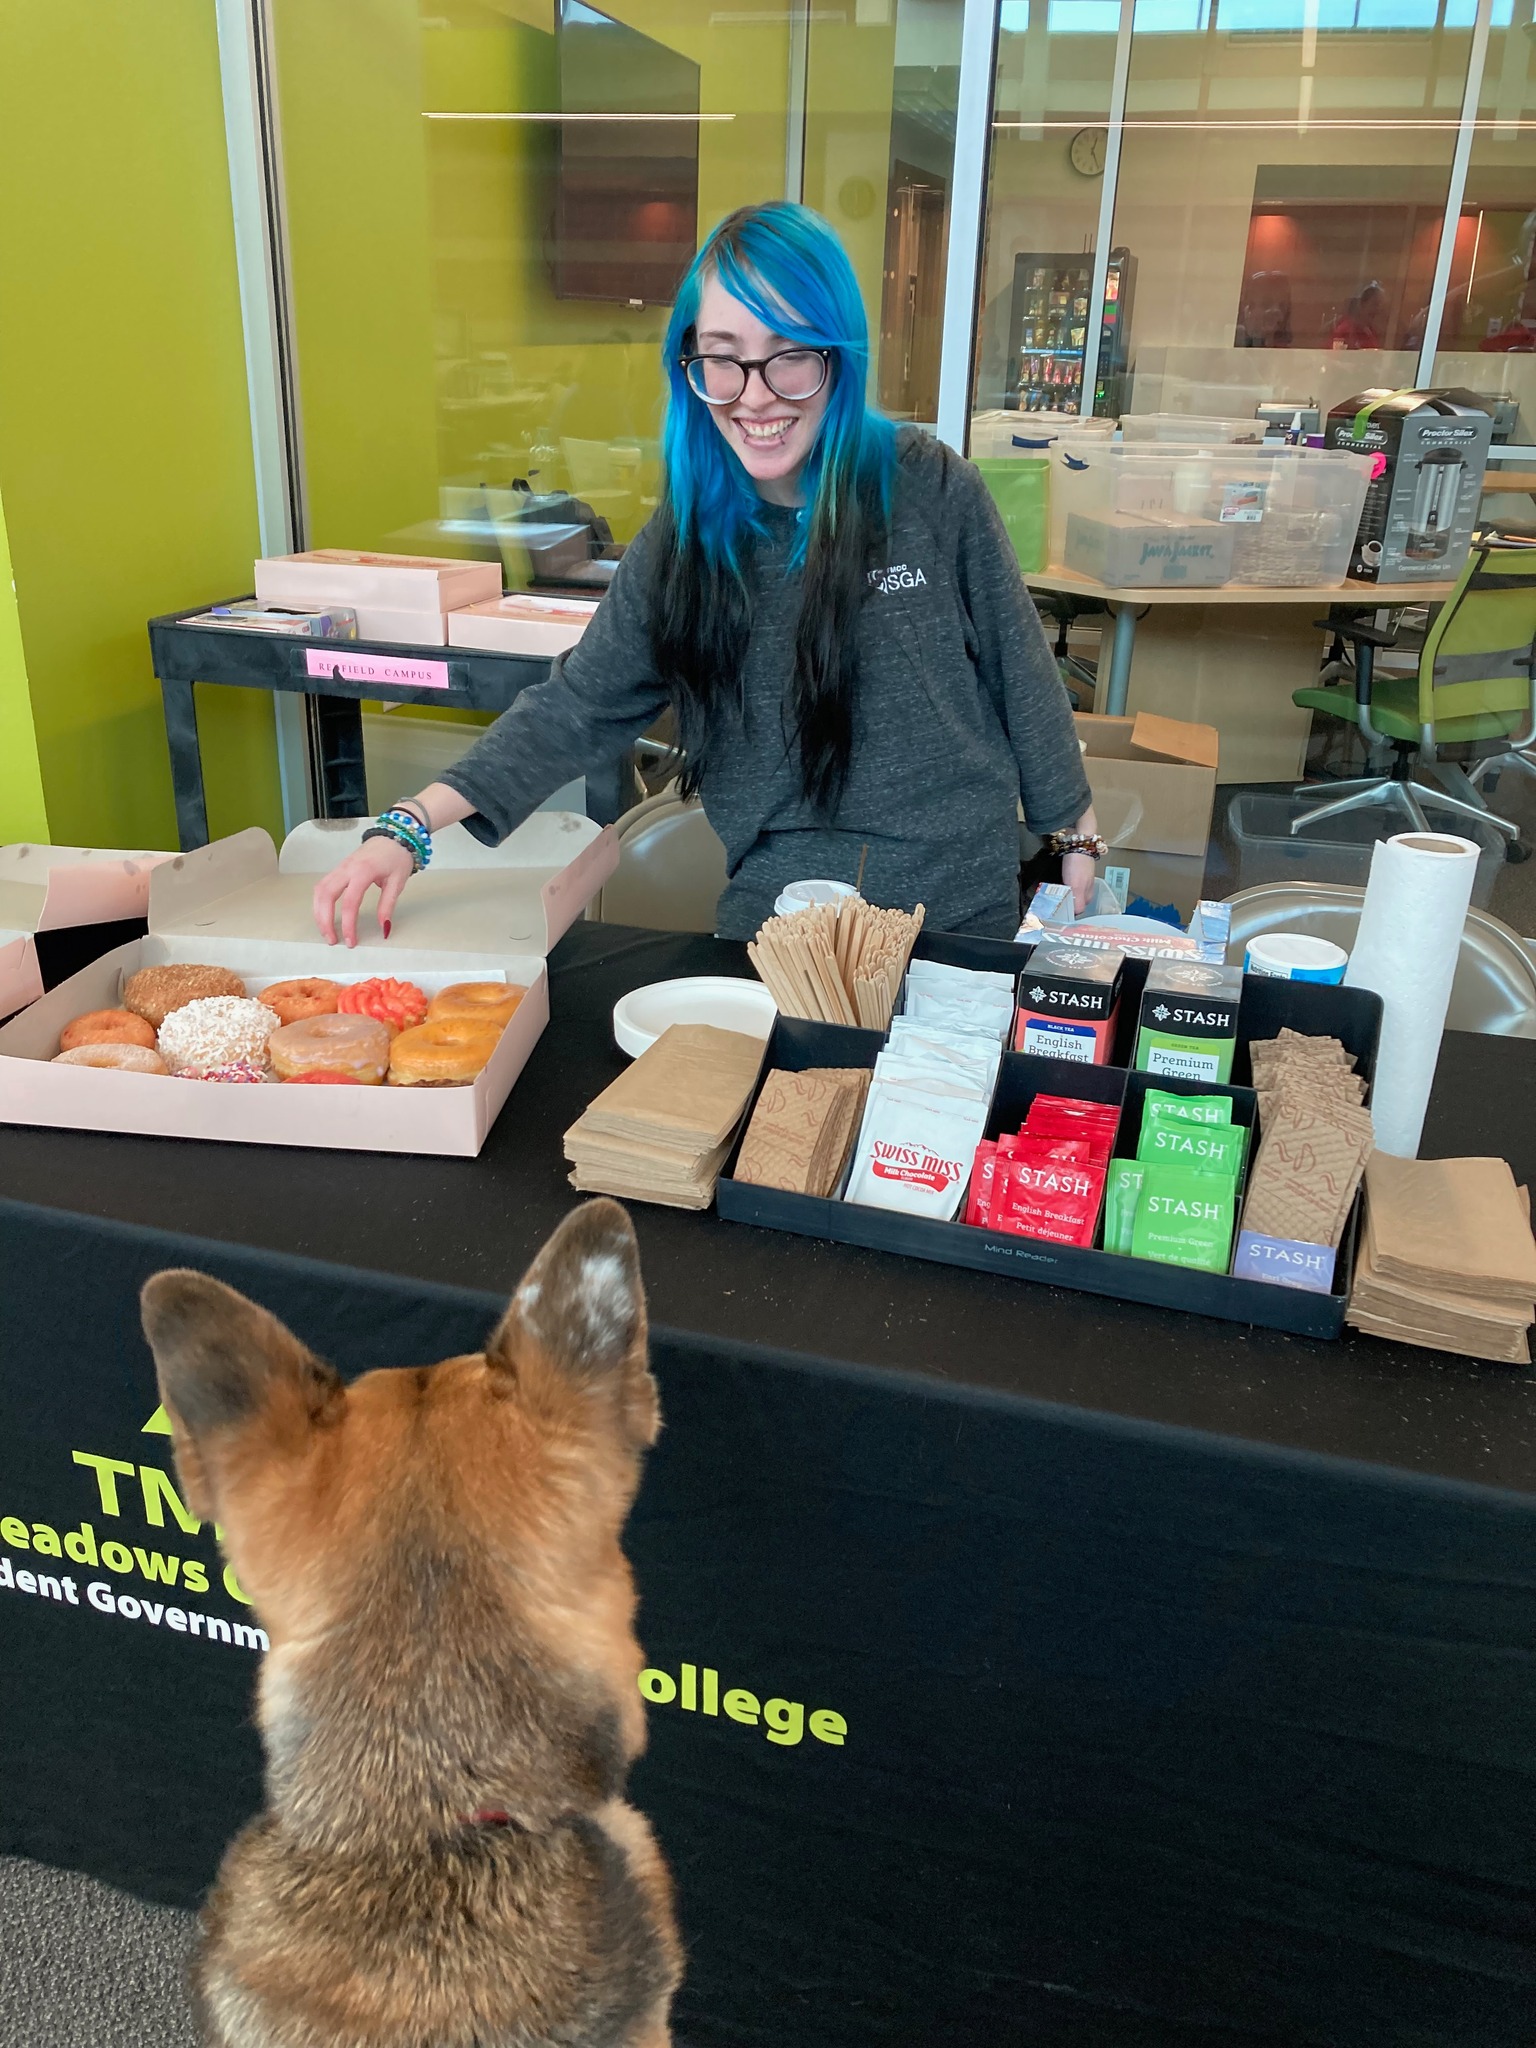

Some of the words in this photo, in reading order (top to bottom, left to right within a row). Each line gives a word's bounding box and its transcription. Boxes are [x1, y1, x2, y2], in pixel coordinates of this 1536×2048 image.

[1453, 429, 1474, 437] Silex
[1336, 441, 1382, 450] COMMERCIAL
[887, 568, 927, 591] SGA
[318, 662, 376, 676] REFIELD
[384, 668, 433, 681] CAMPUS
[1048, 990, 1104, 1010] STASH
[1172, 1008, 1231, 1028] STASH
[1036, 1034, 1083, 1051] English
[1028, 1044, 1089, 1063] Breakfast
[1152, 1052, 1214, 1070] Premium
[1161, 1066, 1201, 1081] Green
[1150, 1102, 1220, 1124] STASH
[869, 1139, 921, 1167] SWISS
[1154, 1131, 1226, 1160] STASH
[883, 1166, 900, 1176] Milk
[899, 1168, 936, 1182] Chocolate
[1019, 1166, 1090, 1197] STASH
[1012, 1202, 1042, 1217] English
[1044, 1210, 1085, 1225] Breakfast
[1148, 1196, 1220, 1220] STASH
[1016, 1221, 1036, 1233] Petit
[1037, 1226, 1074, 1242] déjeuner
[1148, 1232, 1187, 1244] Premium
[1188, 1237, 1214, 1248] Green
[984, 1243, 1013, 1256] Mind
[1015, 1249, 1058, 1264] Reader
[1148, 1250, 1166, 1259] Vert
[1168, 1252, 1179, 1262] de
[1181, 1254, 1212, 1267] qualité
[1249, 1243, 1322, 1270] STASH
[86, 1580, 271, 1653] Governm
[0, 1515, 210, 1593] eadows
[637, 1662, 849, 1746] ollege
